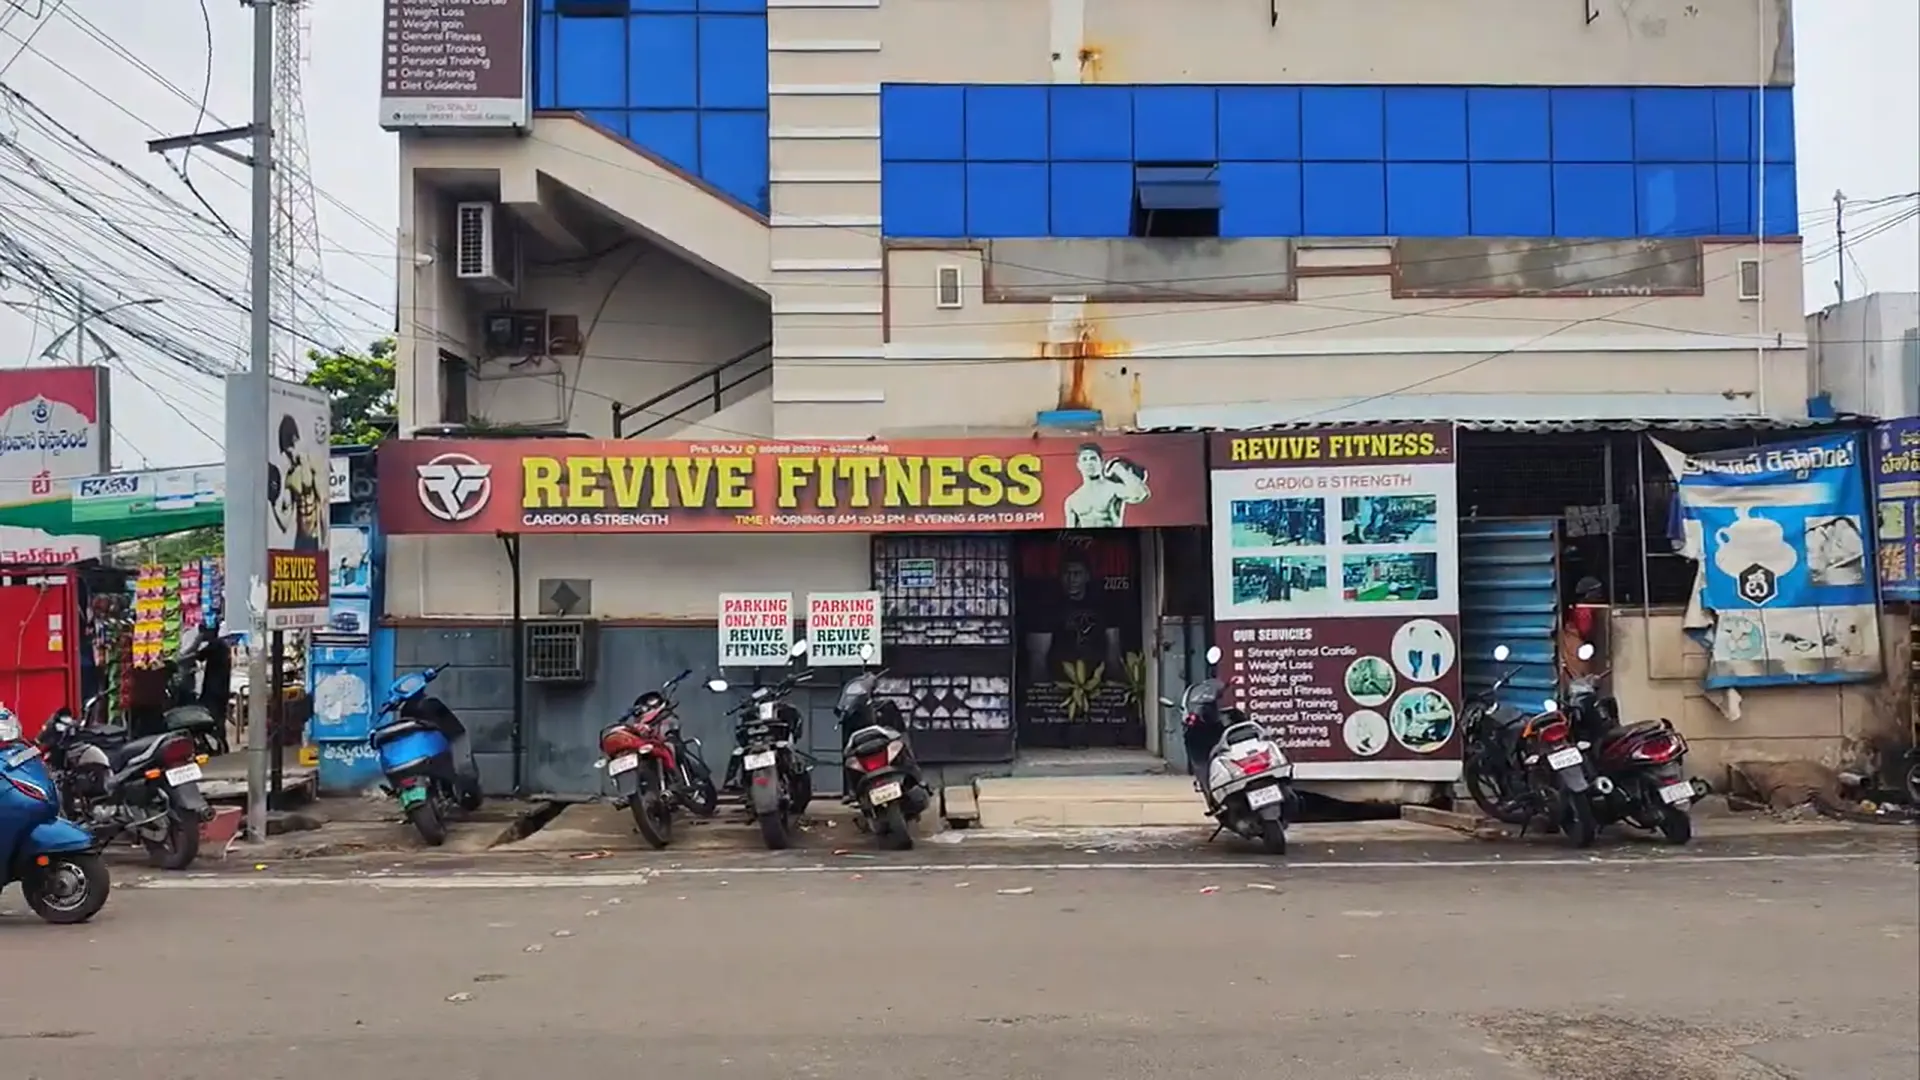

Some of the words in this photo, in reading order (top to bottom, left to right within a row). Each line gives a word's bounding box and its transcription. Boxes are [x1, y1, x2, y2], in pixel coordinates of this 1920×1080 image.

[402, 8, 440, 19] Weight
[441, 8, 465, 17] Loss
[402, 20, 440, 31] Weight
[441, 21, 464, 31] gain
[401, 31, 443, 41] General
[446, 32, 482, 41] Fitness
[401, 43, 443, 53] General
[446, 44, 487, 56] Training
[401, 56, 447, 65] Personal
[450, 57, 491, 69] Training
[401, 69, 434, 78] Online
[401, 81, 421, 90] Diet
[424, 81, 477, 90] Guidelines
[712, 444, 742, 453] RAJU
[1231, 436, 1321, 461] REVIVE
[1329, 433, 1434, 458] FITNESS
[522, 456, 754, 509] REVIVE
[777, 454, 1043, 508] FITNESS
[1255, 475, 1314, 490] CARDIO
[1317, 477, 1329, 489] &
[1331, 474, 1412, 489] STRENGTH
[523, 514, 580, 526] CARDIO
[581, 514, 592, 526] &
[594, 514, 669, 526] STRENGTH
[735, 515, 763, 525] TIME
[770, 514, 825, 525] MORNING
[837, 514, 857, 525] AM
[859, 516, 871, 525] TO
[872, 514, 885, 525] 12
[887, 514, 905, 524] PM
[915, 513, 966, 524] EVENING
[967, 513, 976, 523] 4
[977, 512, 996, 523] PM
[998, 512, 1014, 523] TO
[1025, 511, 1044, 522] PM
[275, 556, 316, 579] REVIVE
[271, 580, 319, 602] FITNESS
[724, 599, 787, 612] PARKING
[812, 599, 874, 612] PARKING
[725, 615, 756, 627] ONLY
[762, 614, 787, 626] FOR
[812, 615, 844, 627] ONLY
[849, 614, 874, 627] FOR
[730, 629, 783, 641] REVIVE
[817, 629, 870, 642] REVIVE
[1233, 629, 1255, 642] OUR
[725, 643, 788, 657] FITNESS
[812, 643, 874, 657] FITNES
[1248, 648, 1297, 659] Strength
[1299, 647, 1318, 656] and
[1322, 645, 1357, 656] Cardio
[1248, 661, 1287, 672] Weight
[1289, 660, 1314, 670] Loss
[1248, 674, 1287, 685] Weight
[1289, 673, 1312, 684] gain
[1249, 686, 1293, 697] General
[1295, 686, 1332, 695] Fitness
[1249, 699, 1293, 710] General
[1296, 698, 1338, 711] Training
[1250, 712, 1299, 722] Personal
[1301, 710, 1343, 724] Training
[1276, 738, 1331, 747] Guidelines
